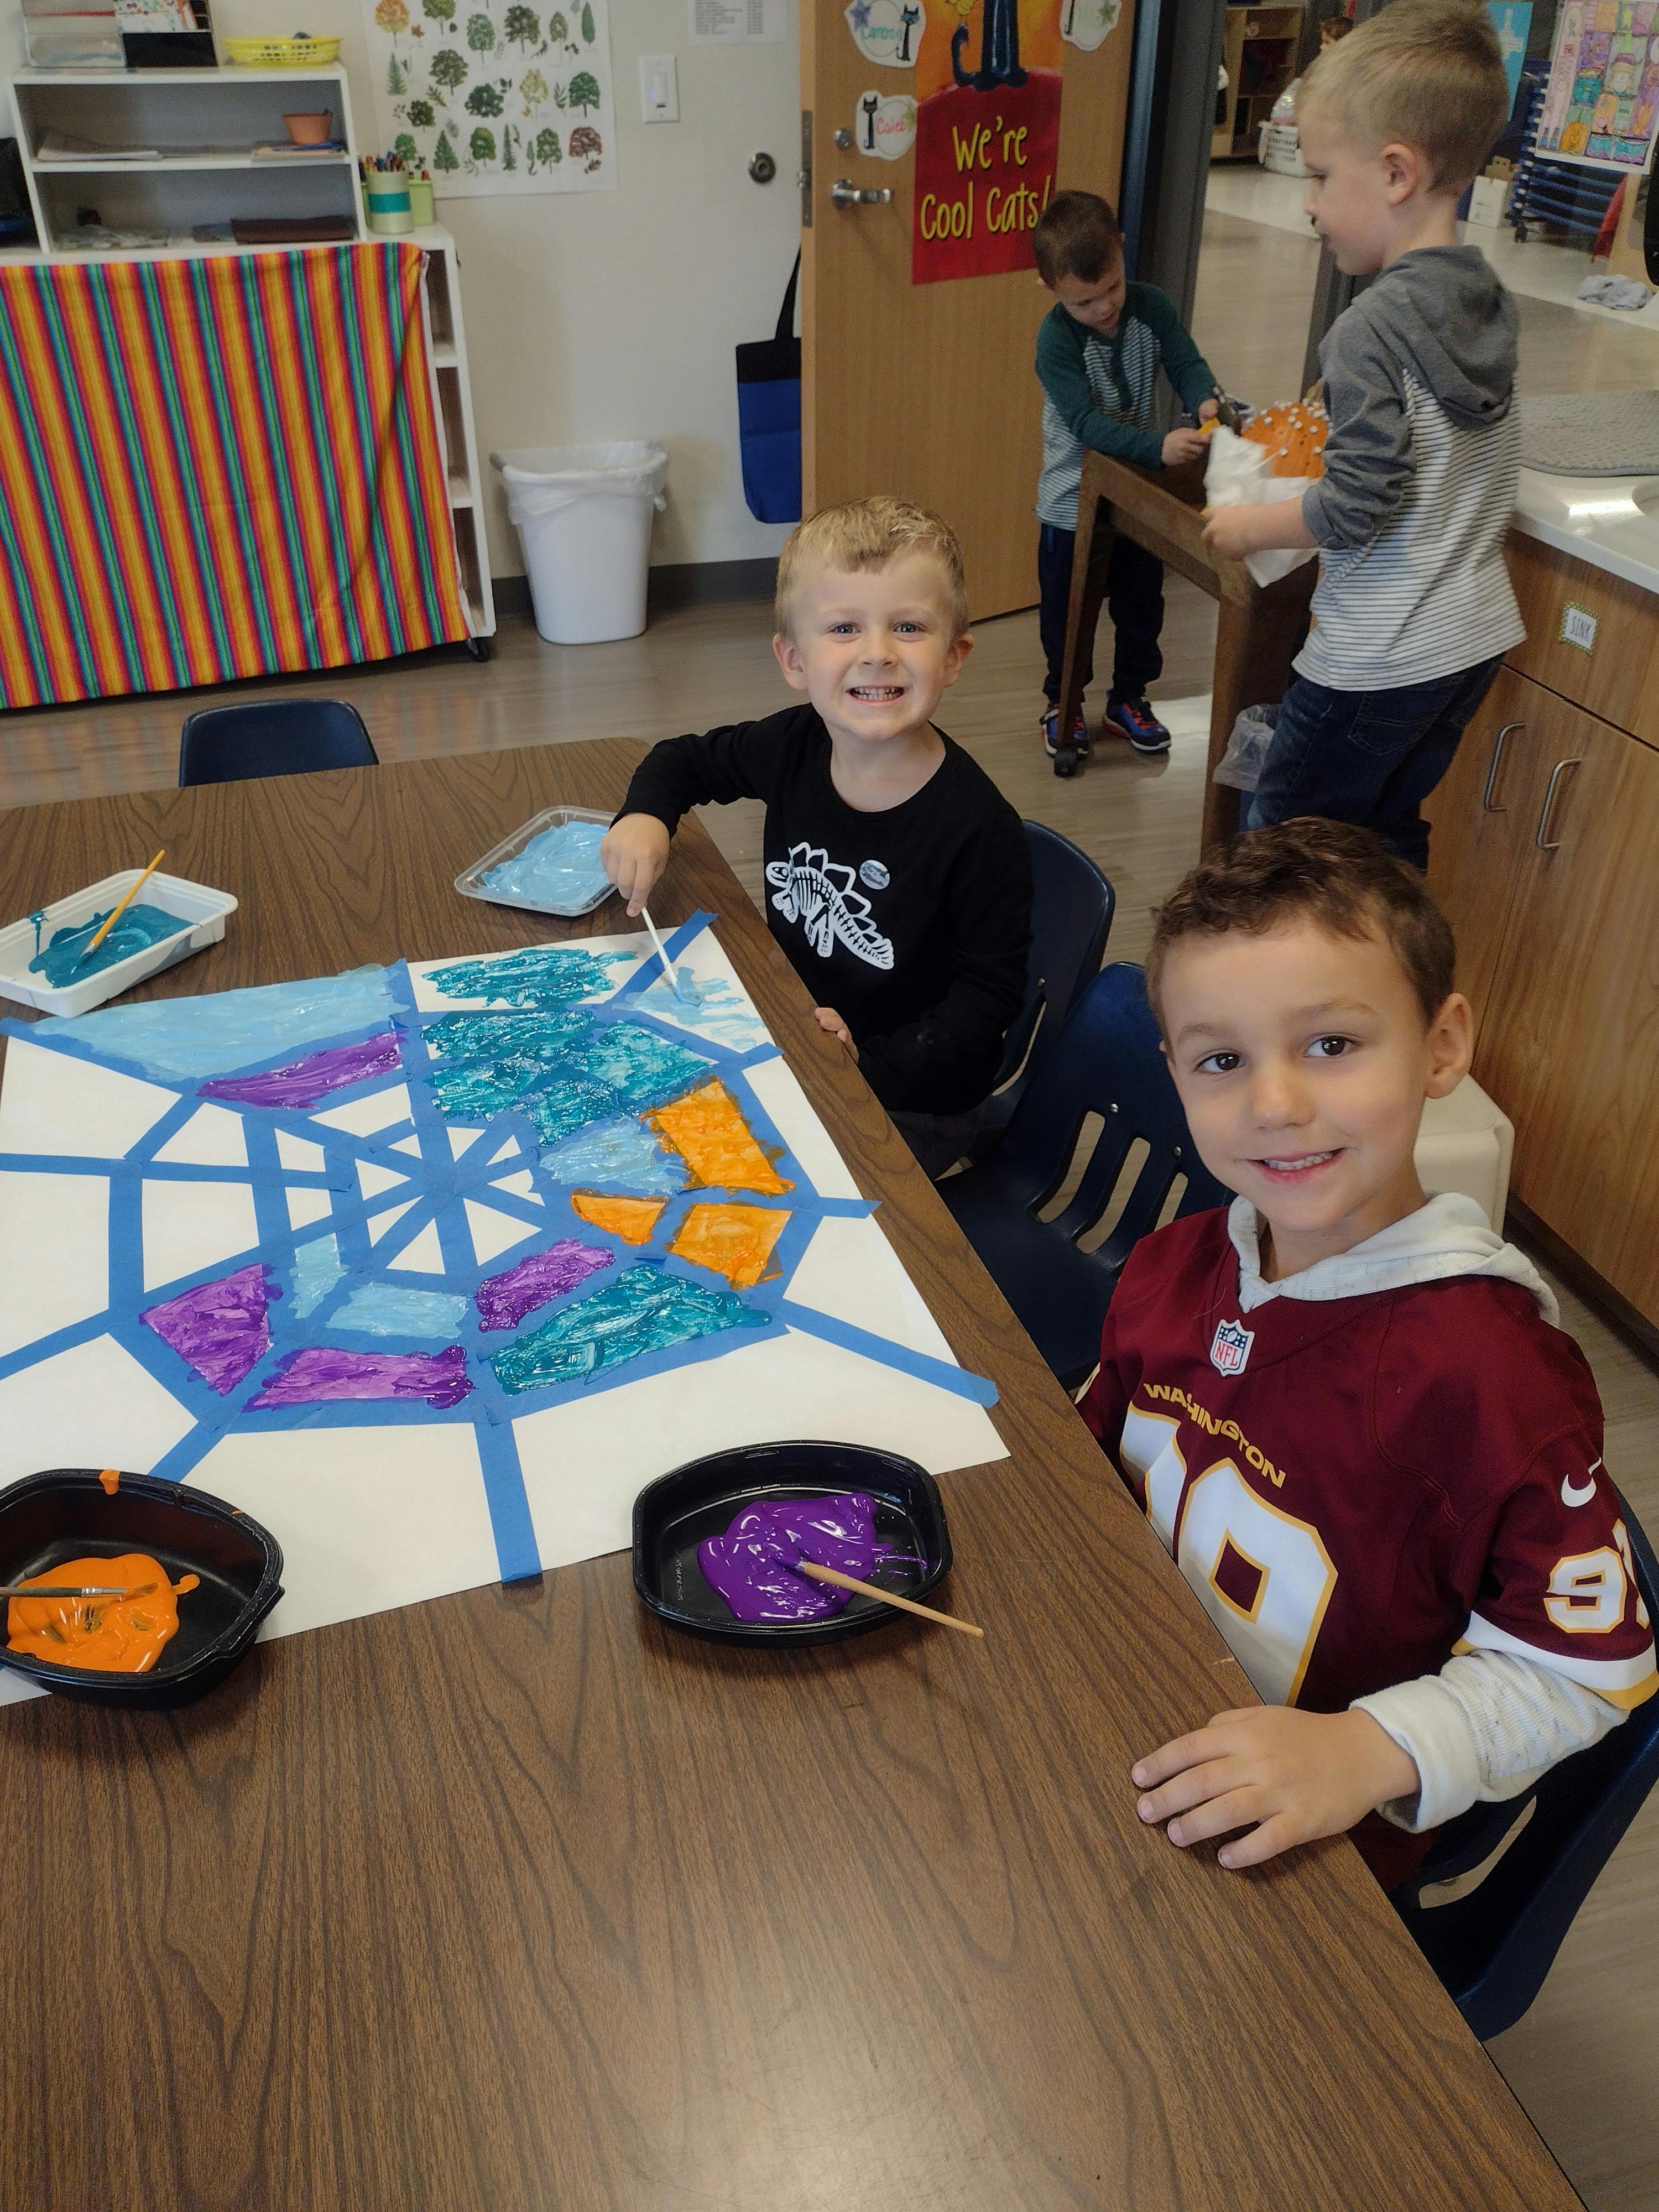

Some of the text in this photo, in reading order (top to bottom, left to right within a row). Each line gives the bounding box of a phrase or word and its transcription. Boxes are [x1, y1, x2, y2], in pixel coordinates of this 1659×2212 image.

[952, 116, 1027, 173] We're
[920, 174, 1051, 240] Cool Cats!
[1569, 615, 1592, 643] SINK
[1215, 1341, 1239, 1366] NFL
